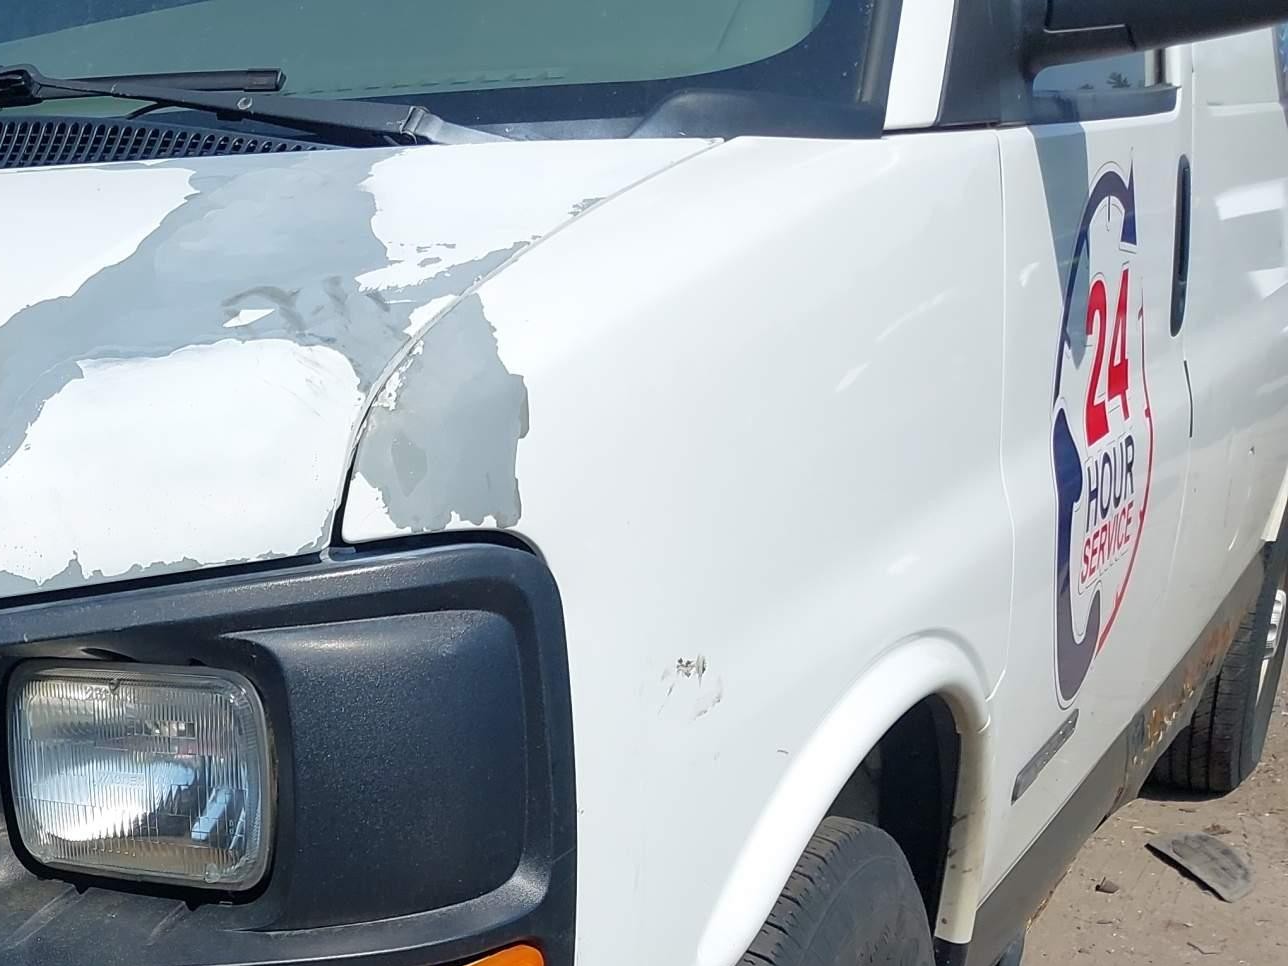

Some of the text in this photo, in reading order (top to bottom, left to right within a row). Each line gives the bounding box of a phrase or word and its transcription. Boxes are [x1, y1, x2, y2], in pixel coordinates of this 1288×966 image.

[1085, 268, 1130, 447] 24
[1085, 434, 1135, 533] HOUR
[1080, 501, 1134, 584] SERVICE
